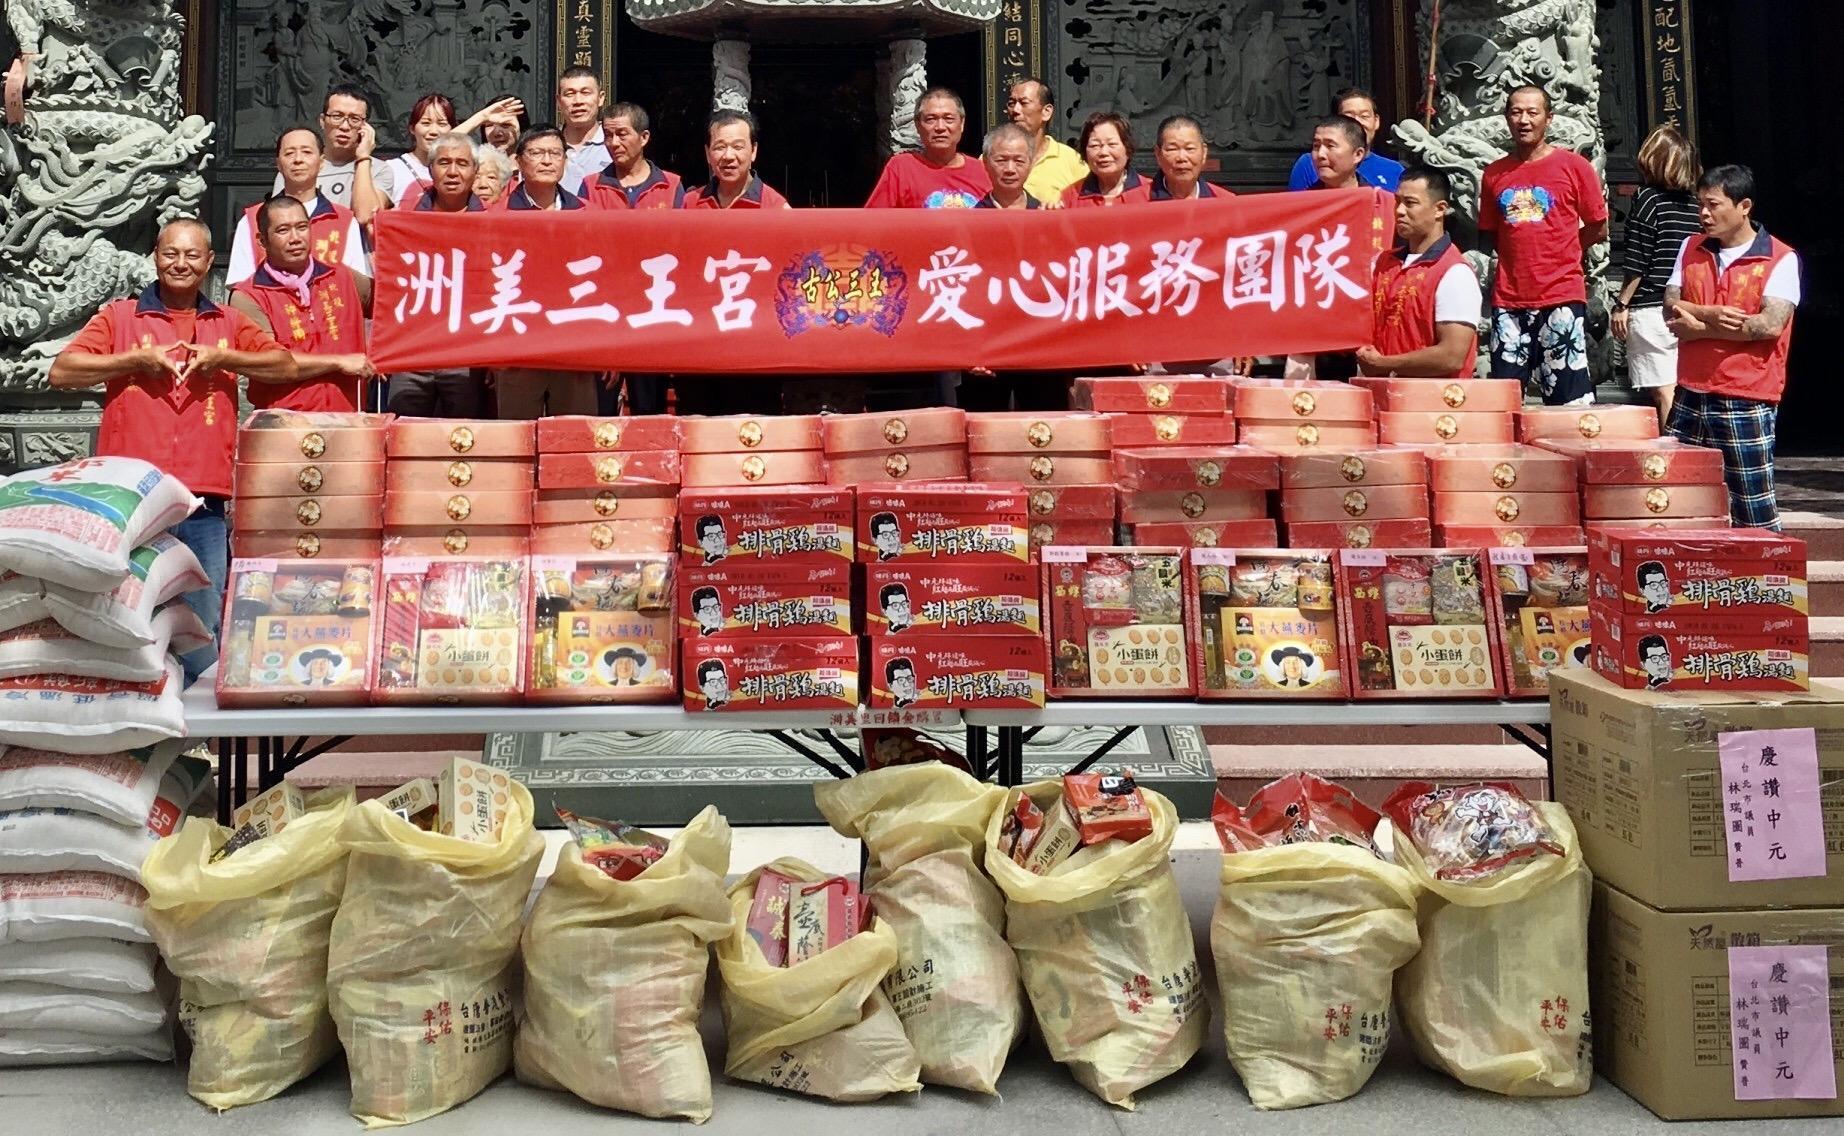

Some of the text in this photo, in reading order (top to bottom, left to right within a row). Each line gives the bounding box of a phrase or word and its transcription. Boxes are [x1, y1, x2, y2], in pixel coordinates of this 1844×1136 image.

[394, 246, 772, 336] 洲美三王宮
[801, 266, 884, 304] 古公三王
[917, 222, 1370, 330] 愛心服務團隊
[448, 649, 490, 662] 小蛋餅
[1116, 648, 1159, 661] 小蛋餅
[1420, 648, 1463, 662] 小蛋餅
[1741, 762, 1755, 837] 台北市議員
[1759, 745, 1787, 862] 慶讚中元
[422, 1008, 438, 1045] 平安
[437, 1000, 453, 1035] 保佑
[1323, 1007, 1338, 1042] 平安
[1339, 1003, 1353, 1038] 保佑
[1554, 995, 1570, 1030] 保佑
[1750, 979, 1762, 1055] 台北市議員
[1769, 962, 1794, 1080] 慶讚中元
